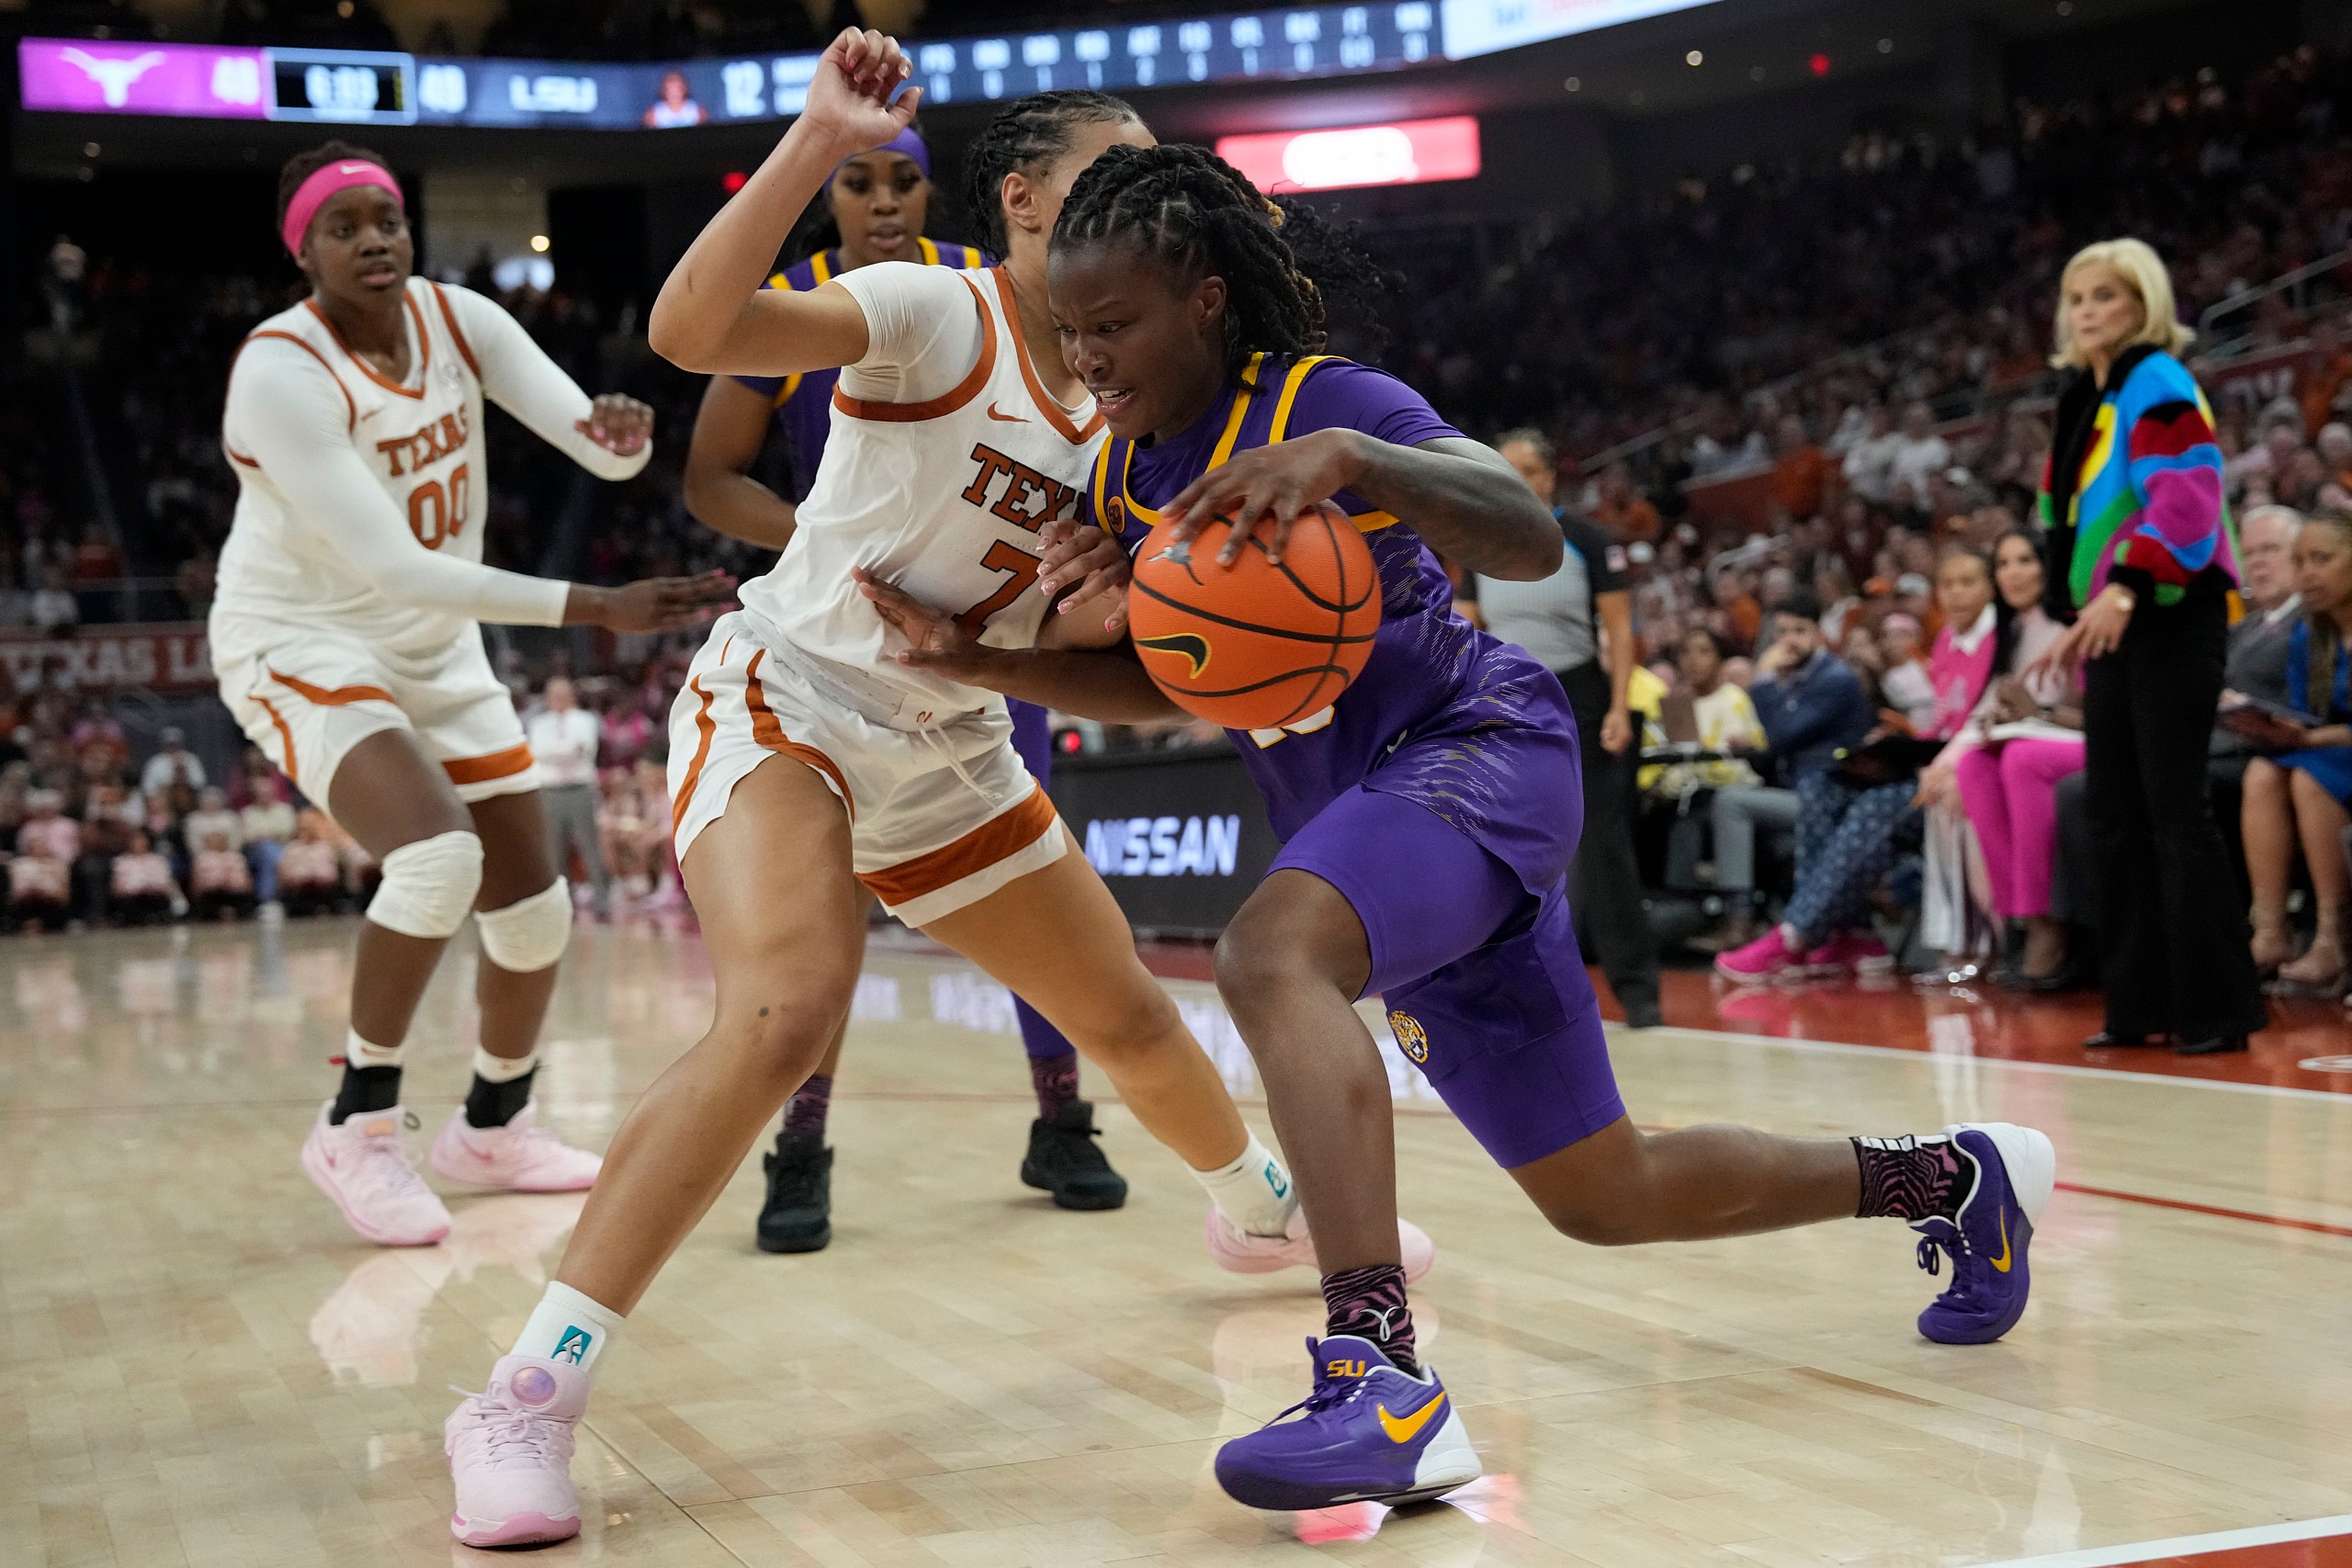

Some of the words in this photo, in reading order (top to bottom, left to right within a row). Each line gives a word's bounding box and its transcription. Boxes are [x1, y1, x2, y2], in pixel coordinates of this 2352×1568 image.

[508, 74, 598, 113] LSU
[721, 62, 766, 117] 12
[376, 403, 469, 477] TEXAS
[408, 463, 469, 550] 00
[961, 442, 1088, 535] TEX
[951, 538, 1044, 640] 7
[1084, 814, 1240, 876] NISSAN
